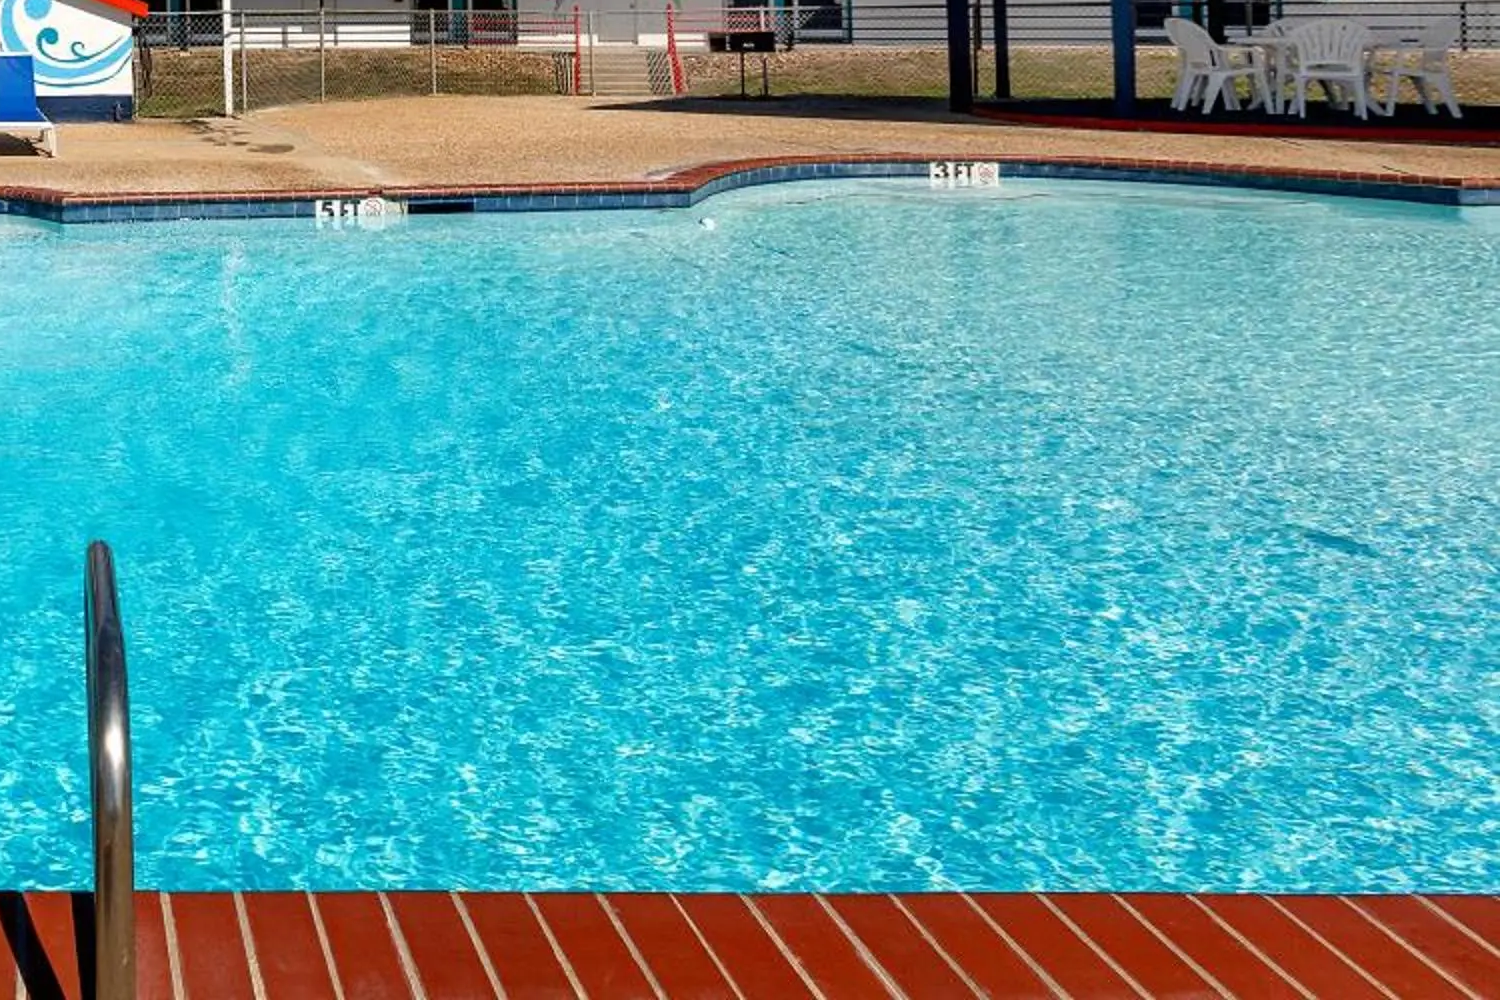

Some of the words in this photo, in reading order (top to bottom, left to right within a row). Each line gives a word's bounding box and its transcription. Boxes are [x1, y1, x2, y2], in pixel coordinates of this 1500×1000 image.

[934, 162, 949, 178] 3
[954, 163, 974, 178] FT
[322, 201, 334, 216] 5
[340, 200, 360, 216] FT
